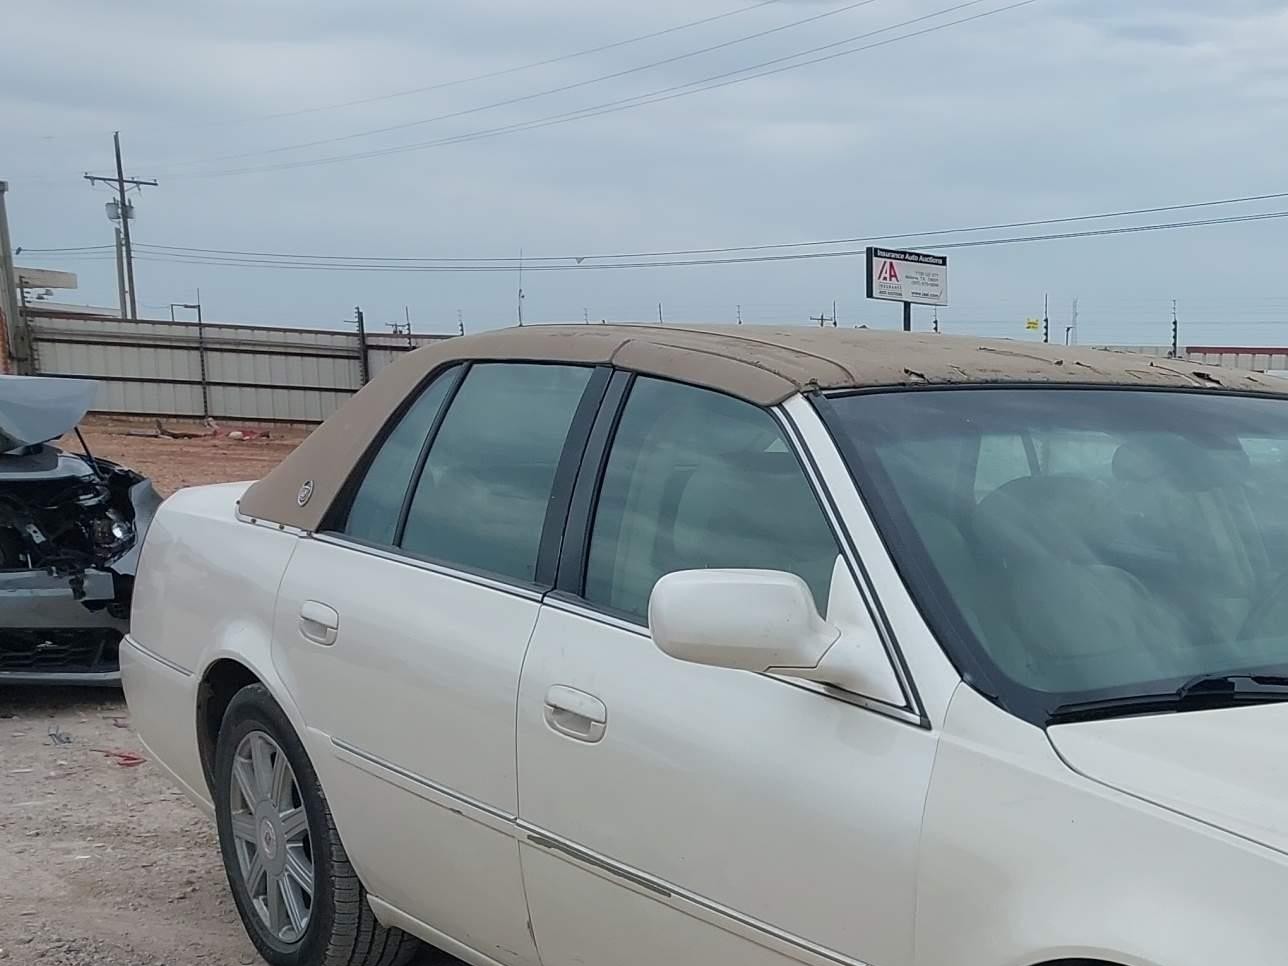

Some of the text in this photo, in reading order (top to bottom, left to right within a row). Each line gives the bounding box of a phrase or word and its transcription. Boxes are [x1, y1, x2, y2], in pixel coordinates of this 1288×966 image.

[877, 249, 943, 265] Insurance Auto Auctions
